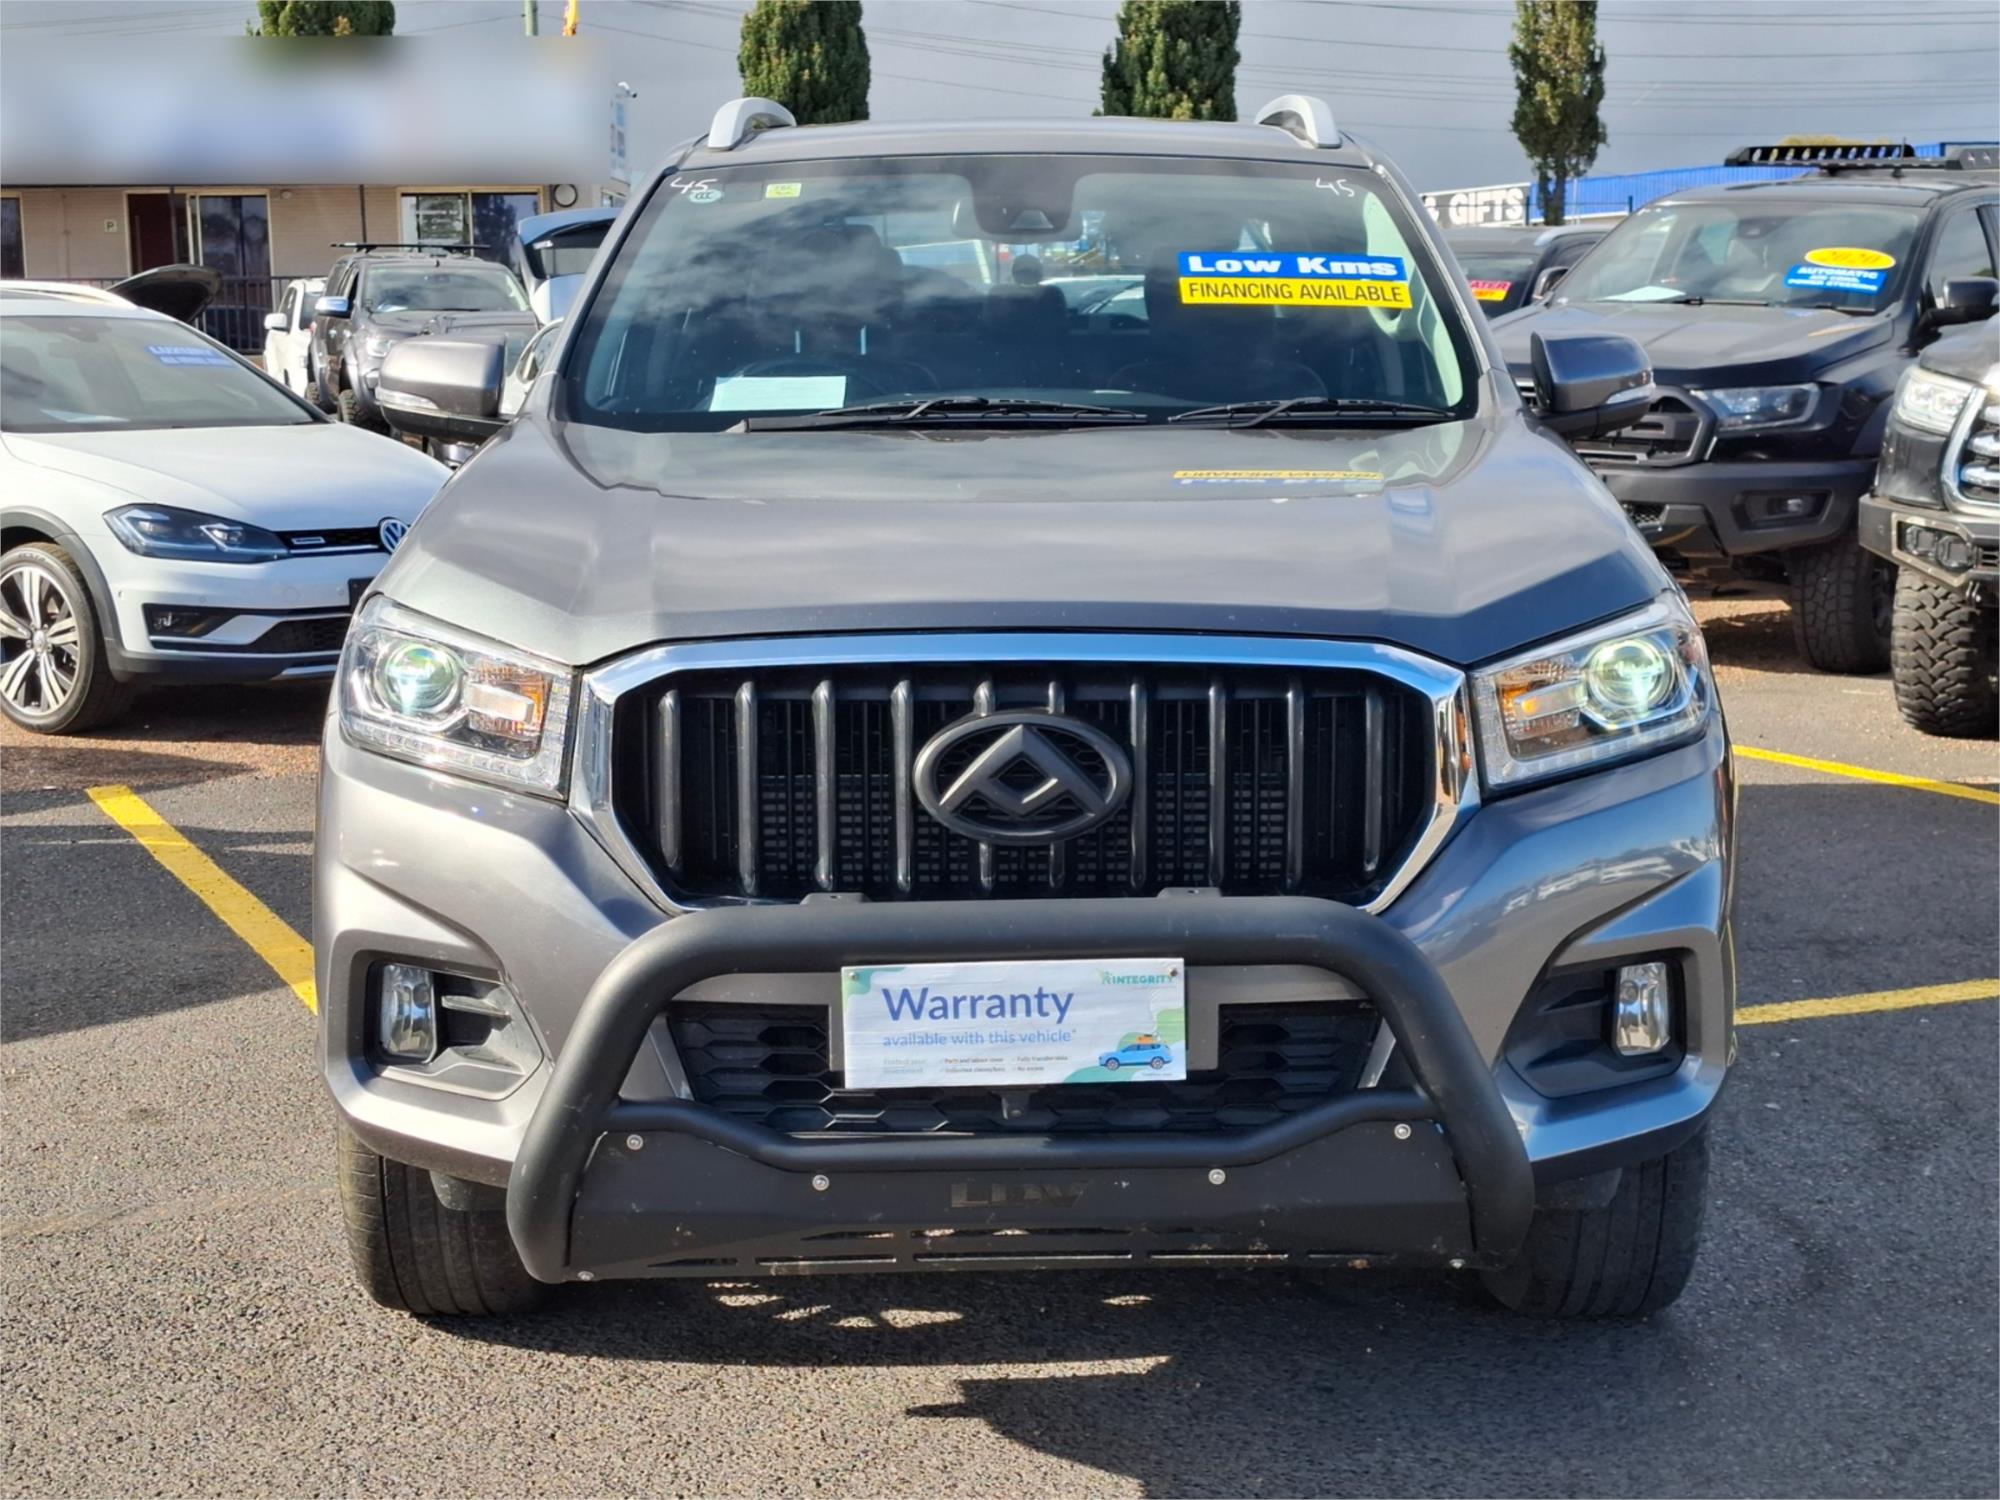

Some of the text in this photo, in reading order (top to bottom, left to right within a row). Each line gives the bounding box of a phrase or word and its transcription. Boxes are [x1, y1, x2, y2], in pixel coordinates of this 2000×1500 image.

[669, 177, 718, 194] 45
[1315, 177, 1355, 197] 45
[1448, 187, 1524, 226] GIFTS
[1187, 255, 1399, 277] Low Kms
[1188, 281, 1405, 303] FINANCING AVAILABLE
[1112, 975, 1174, 985] INTEGRITY
[881, 986, 1075, 1024] Warranty
[883, 1031, 948, 1047] available
[949, 1031, 985, 1045] with
[988, 1029, 1016, 1044] this
